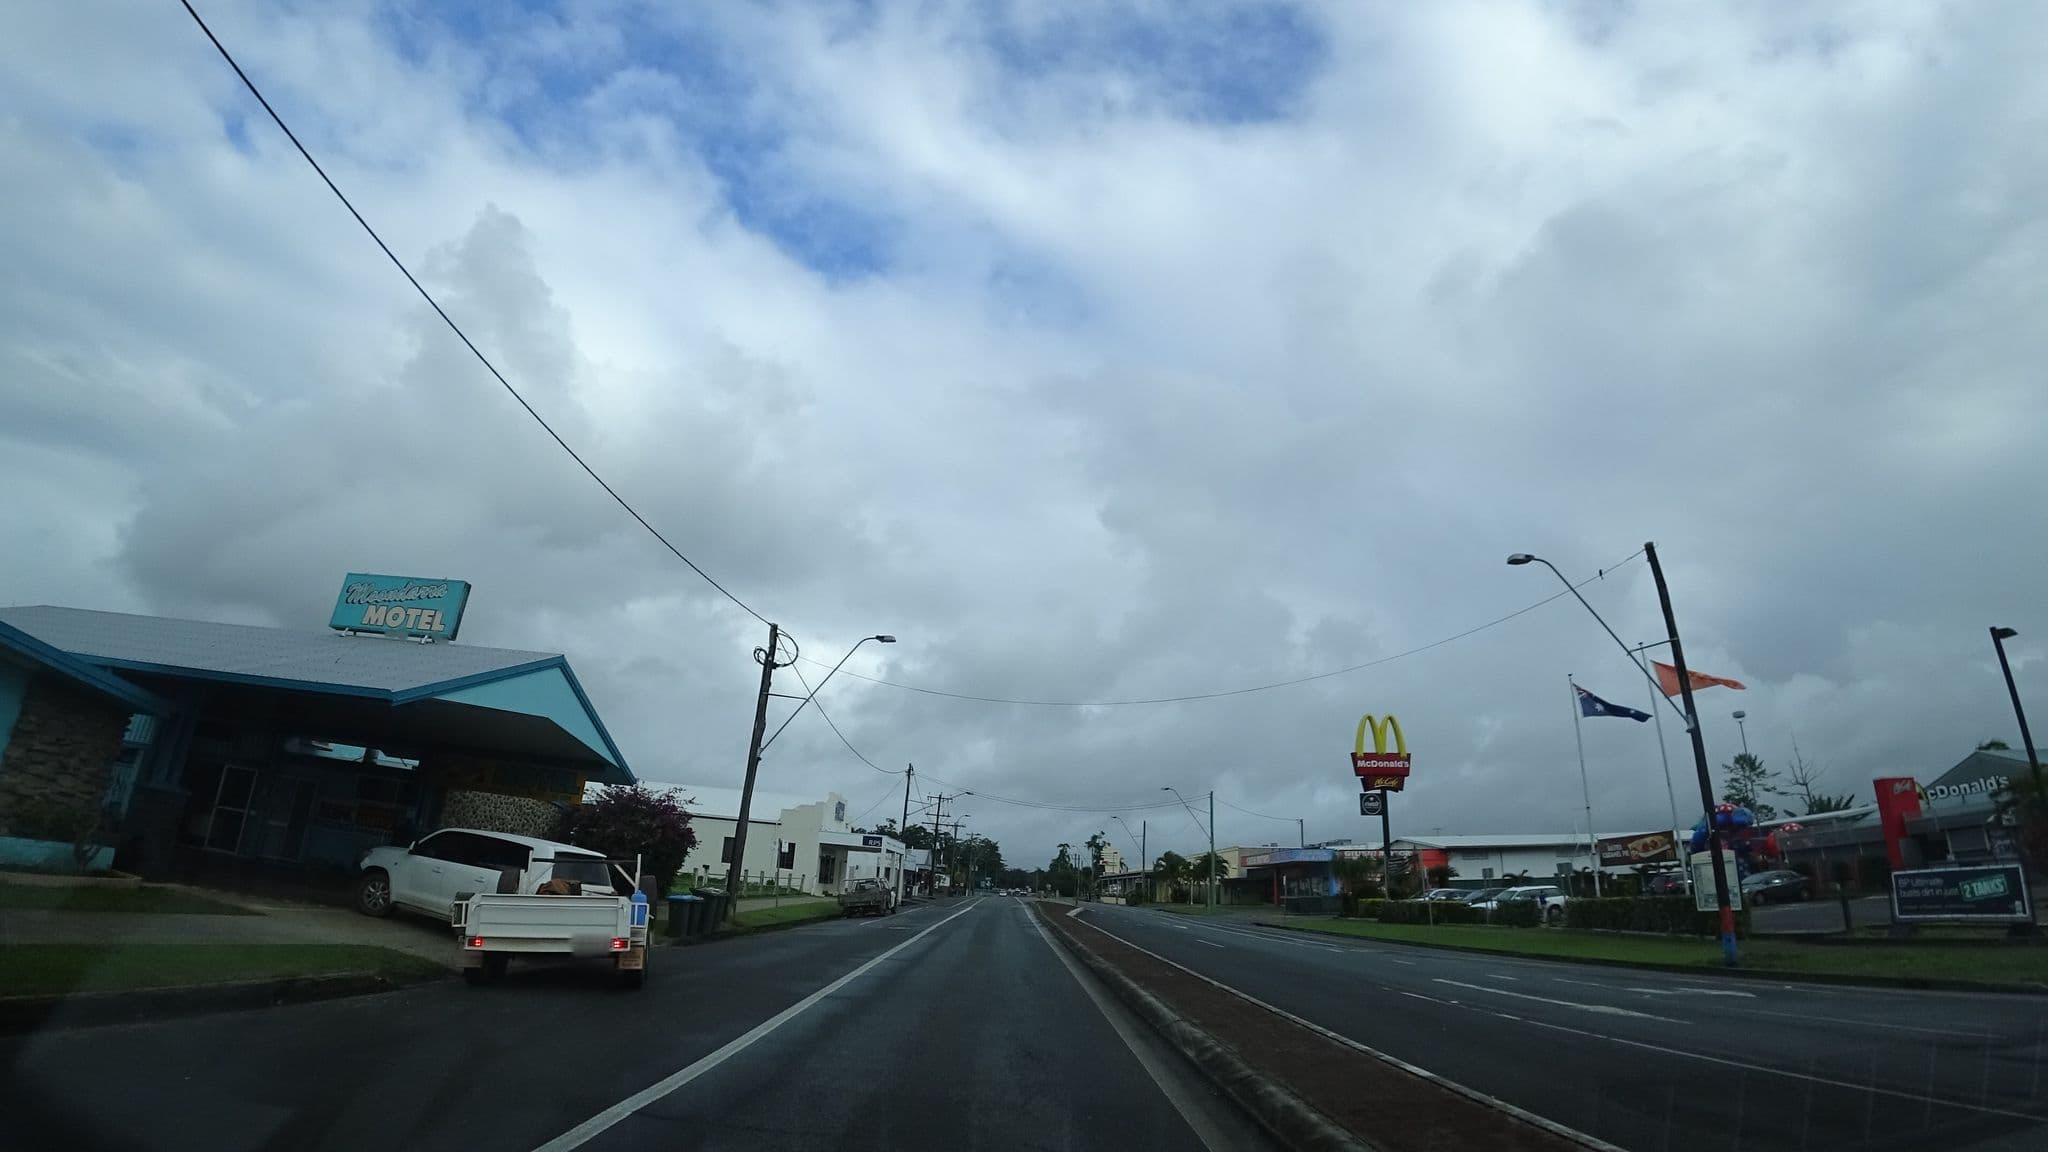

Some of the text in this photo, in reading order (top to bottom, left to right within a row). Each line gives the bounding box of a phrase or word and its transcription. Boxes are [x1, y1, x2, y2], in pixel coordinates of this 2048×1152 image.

[362, 605, 445, 631] MOTEL
[1357, 760, 1409, 768] McDonald's
[1963, 884, 1972, 898] 2
[1972, 877, 2004, 896] TANKS
